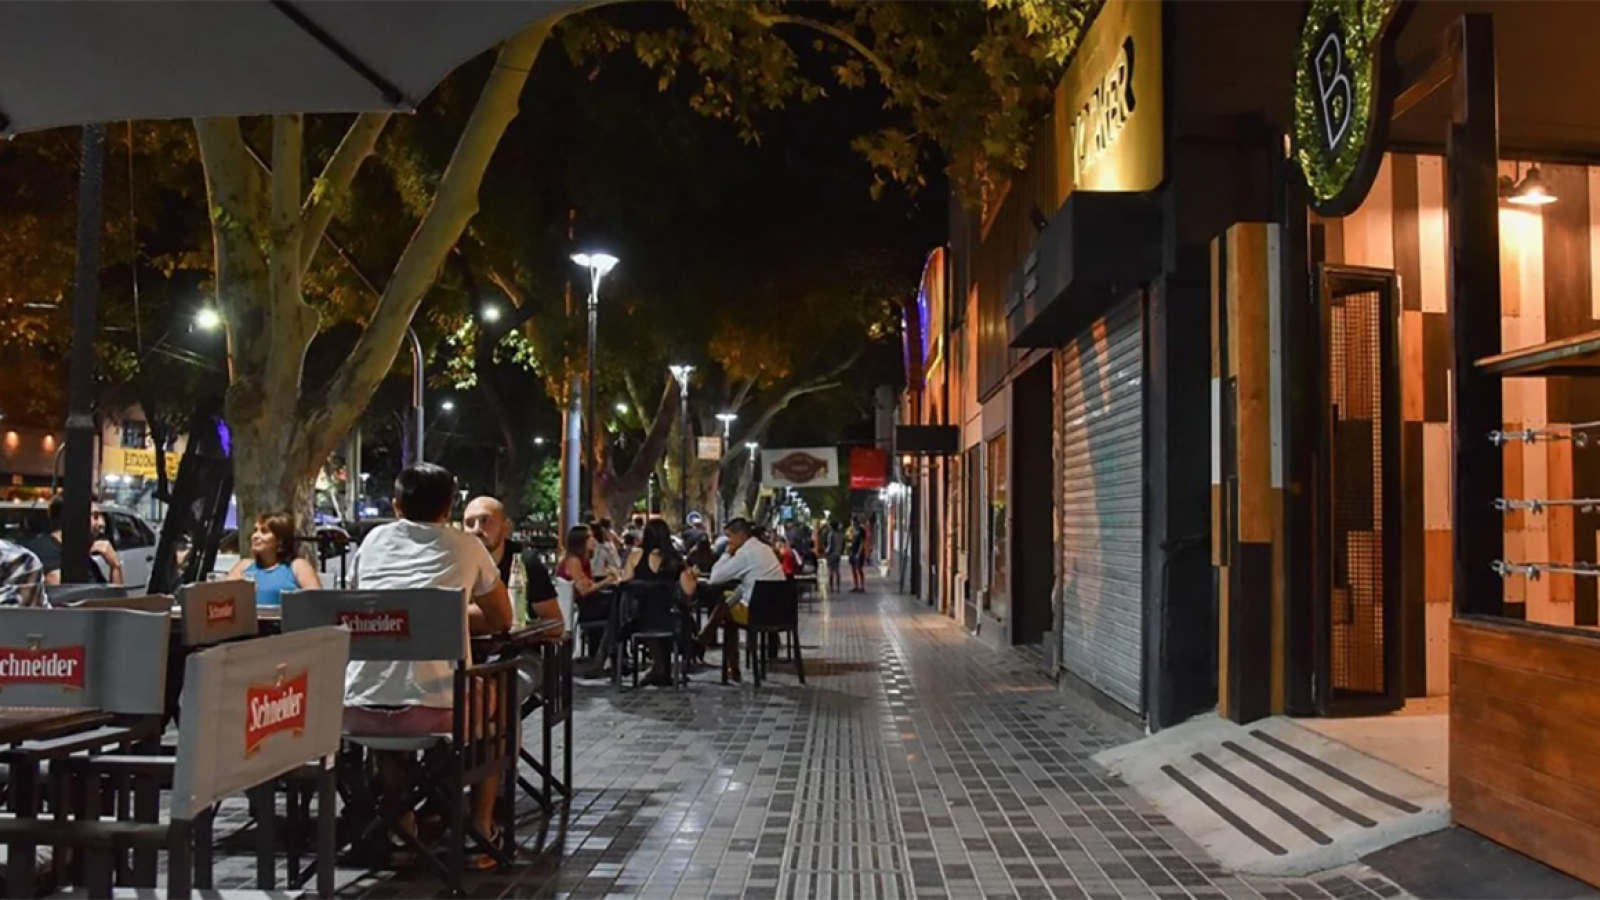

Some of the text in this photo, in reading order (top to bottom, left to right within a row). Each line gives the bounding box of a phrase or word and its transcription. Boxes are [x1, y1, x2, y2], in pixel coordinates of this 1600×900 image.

[1315, 33, 1351, 149] B
[0, 652, 78, 677] chneider
[249, 685, 304, 732] Schneider
